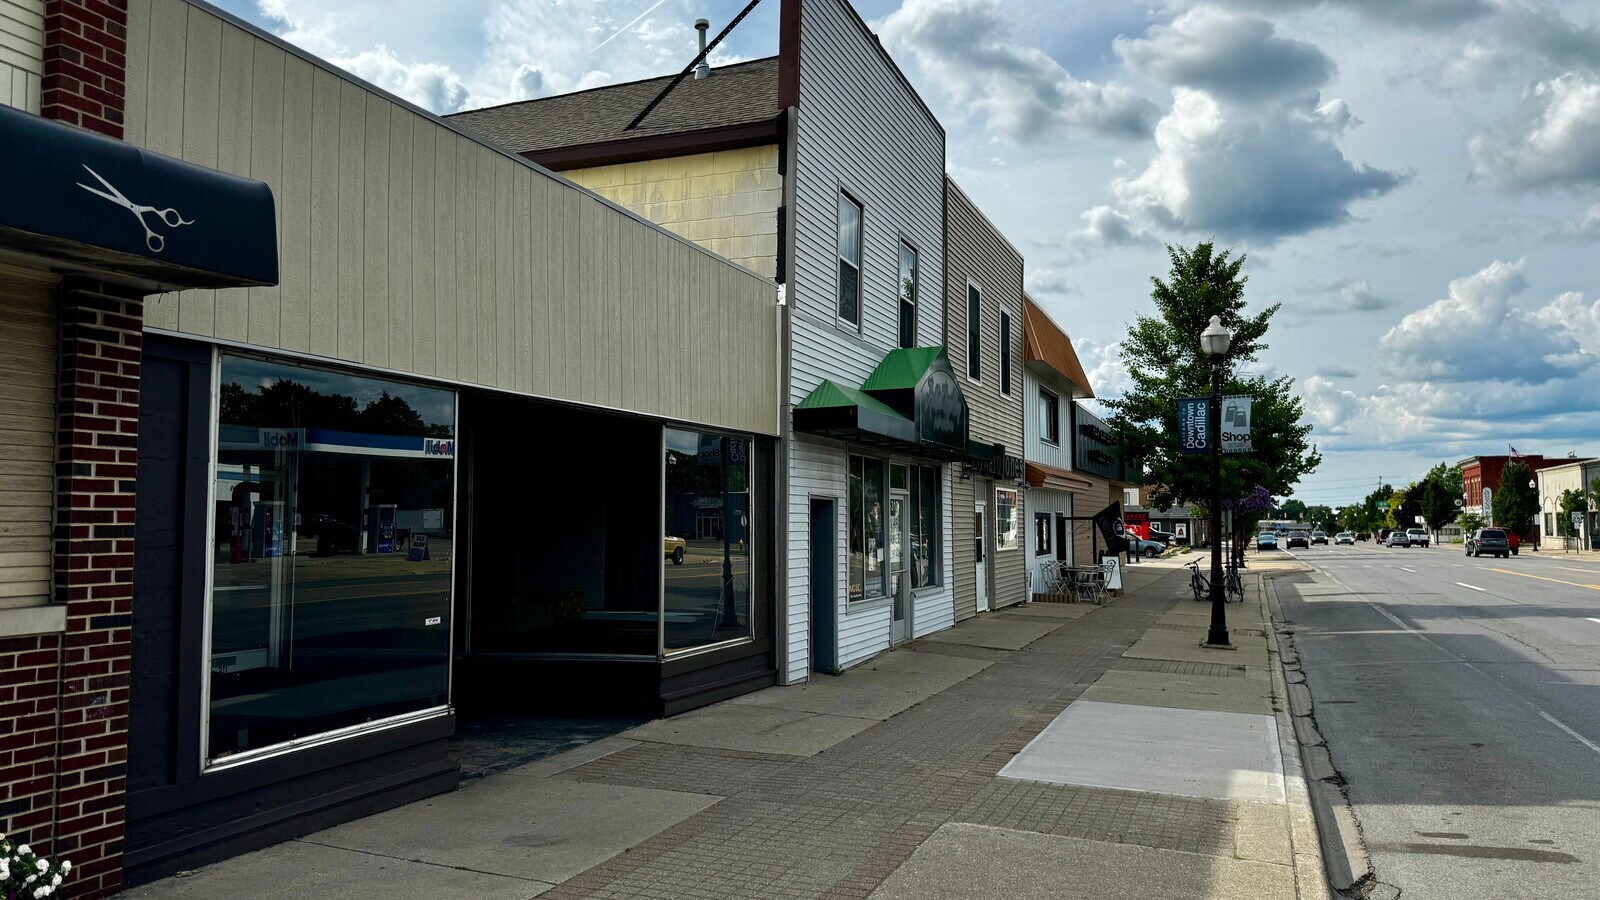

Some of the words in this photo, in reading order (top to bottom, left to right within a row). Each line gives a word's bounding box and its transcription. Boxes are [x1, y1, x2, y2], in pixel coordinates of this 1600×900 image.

[1186, 403, 1195, 449] Downtown
[1194, 402, 1206, 448] Cadillac
[1221, 431, 1251, 443] Shop
